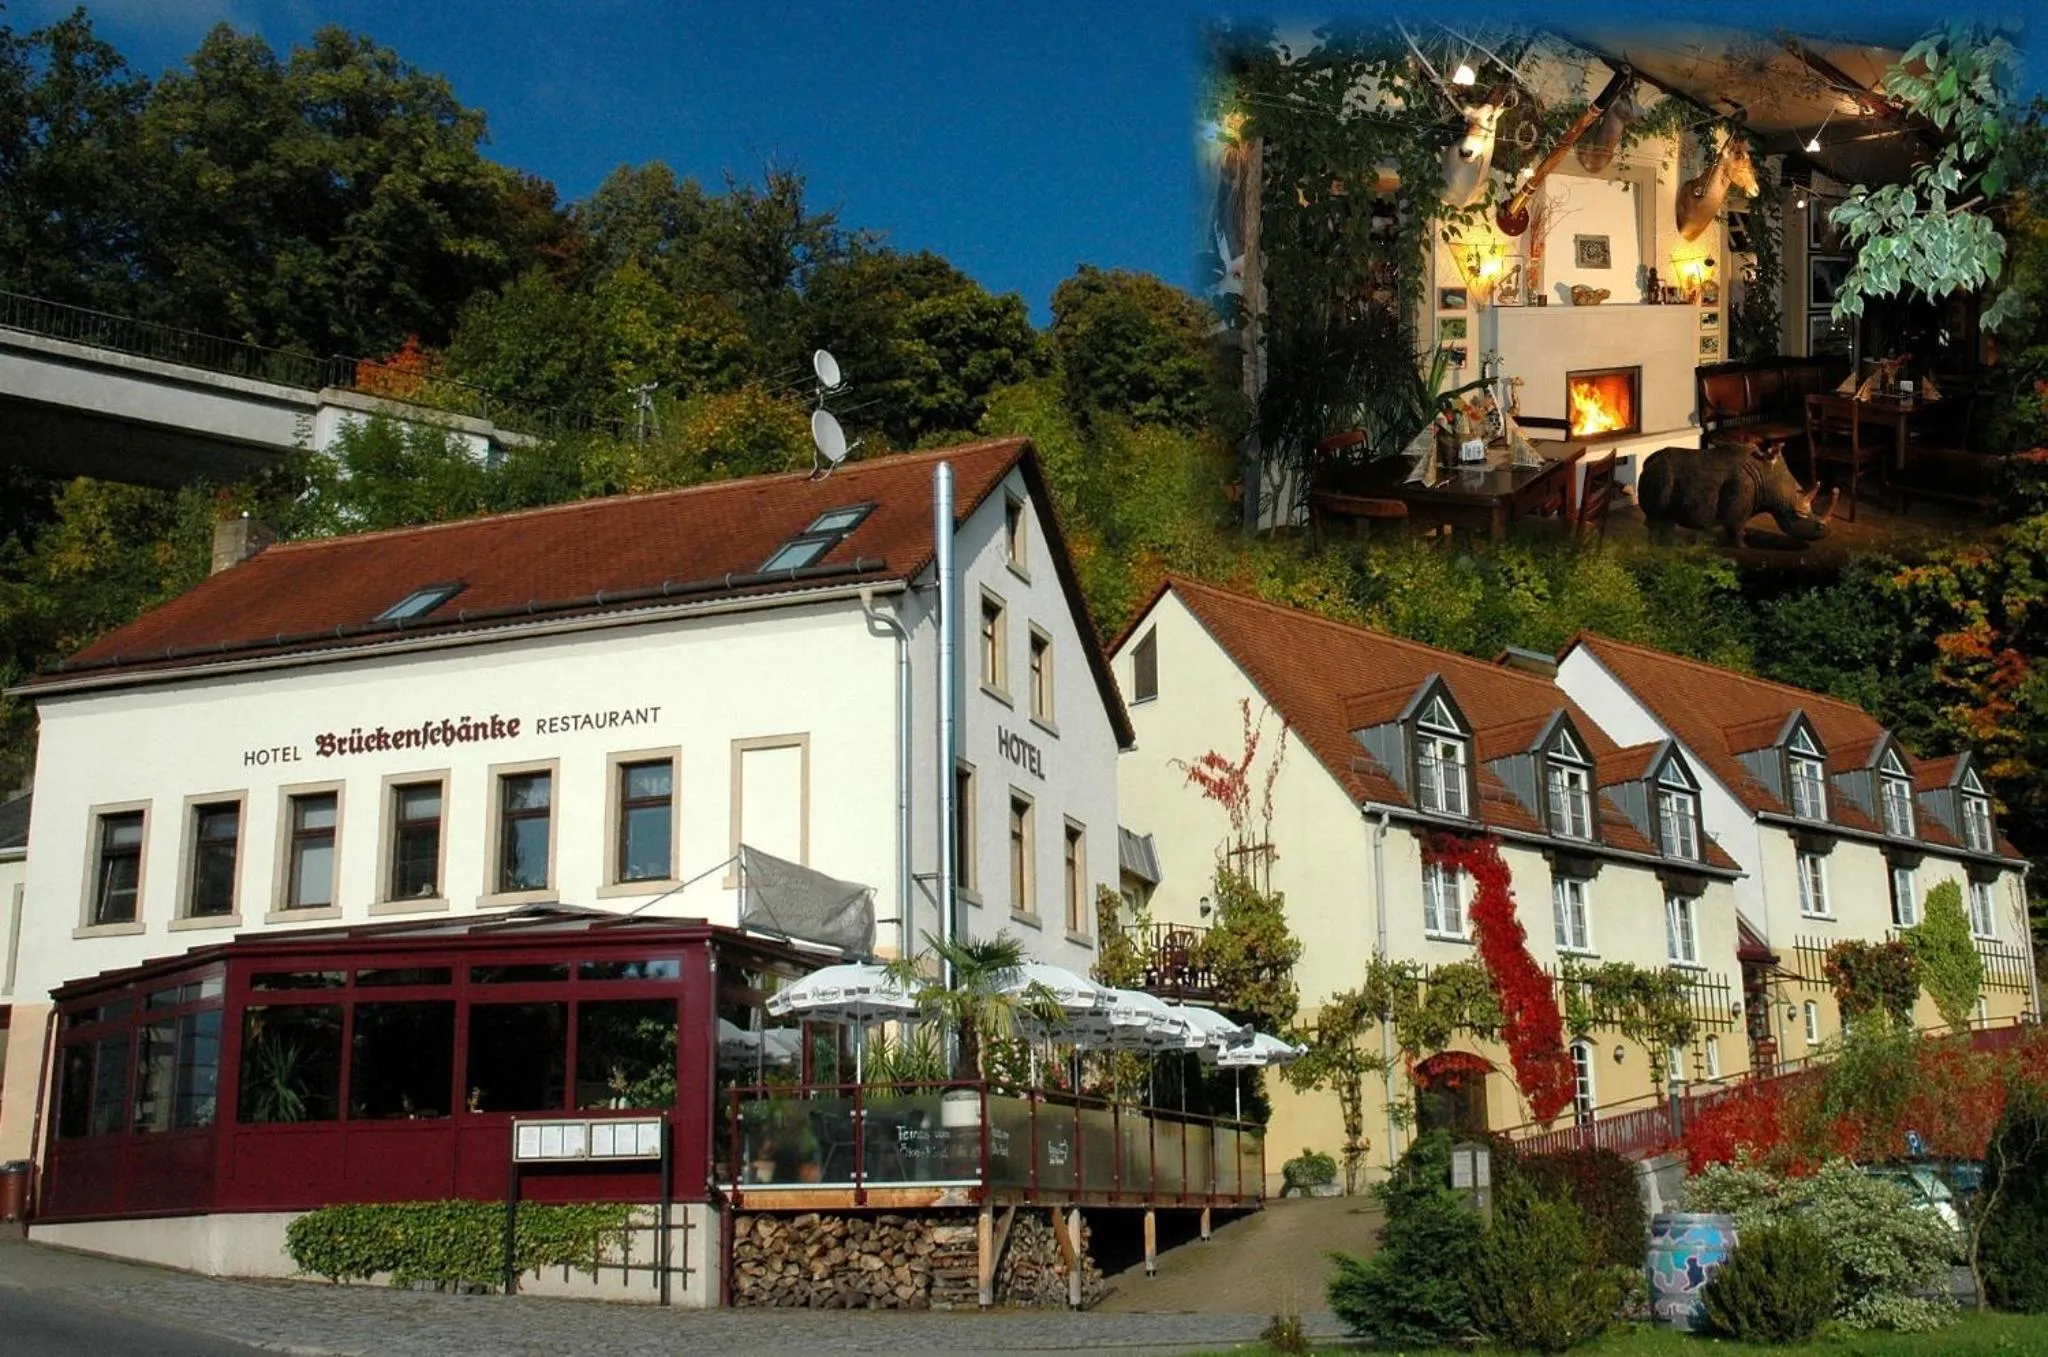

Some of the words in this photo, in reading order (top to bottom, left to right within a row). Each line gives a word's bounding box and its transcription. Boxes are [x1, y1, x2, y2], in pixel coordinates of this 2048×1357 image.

[244, 746, 302, 766] HOTEL
[536, 707, 661, 735] RESTAURANT
[998, 725, 1045, 780] HOTEL
